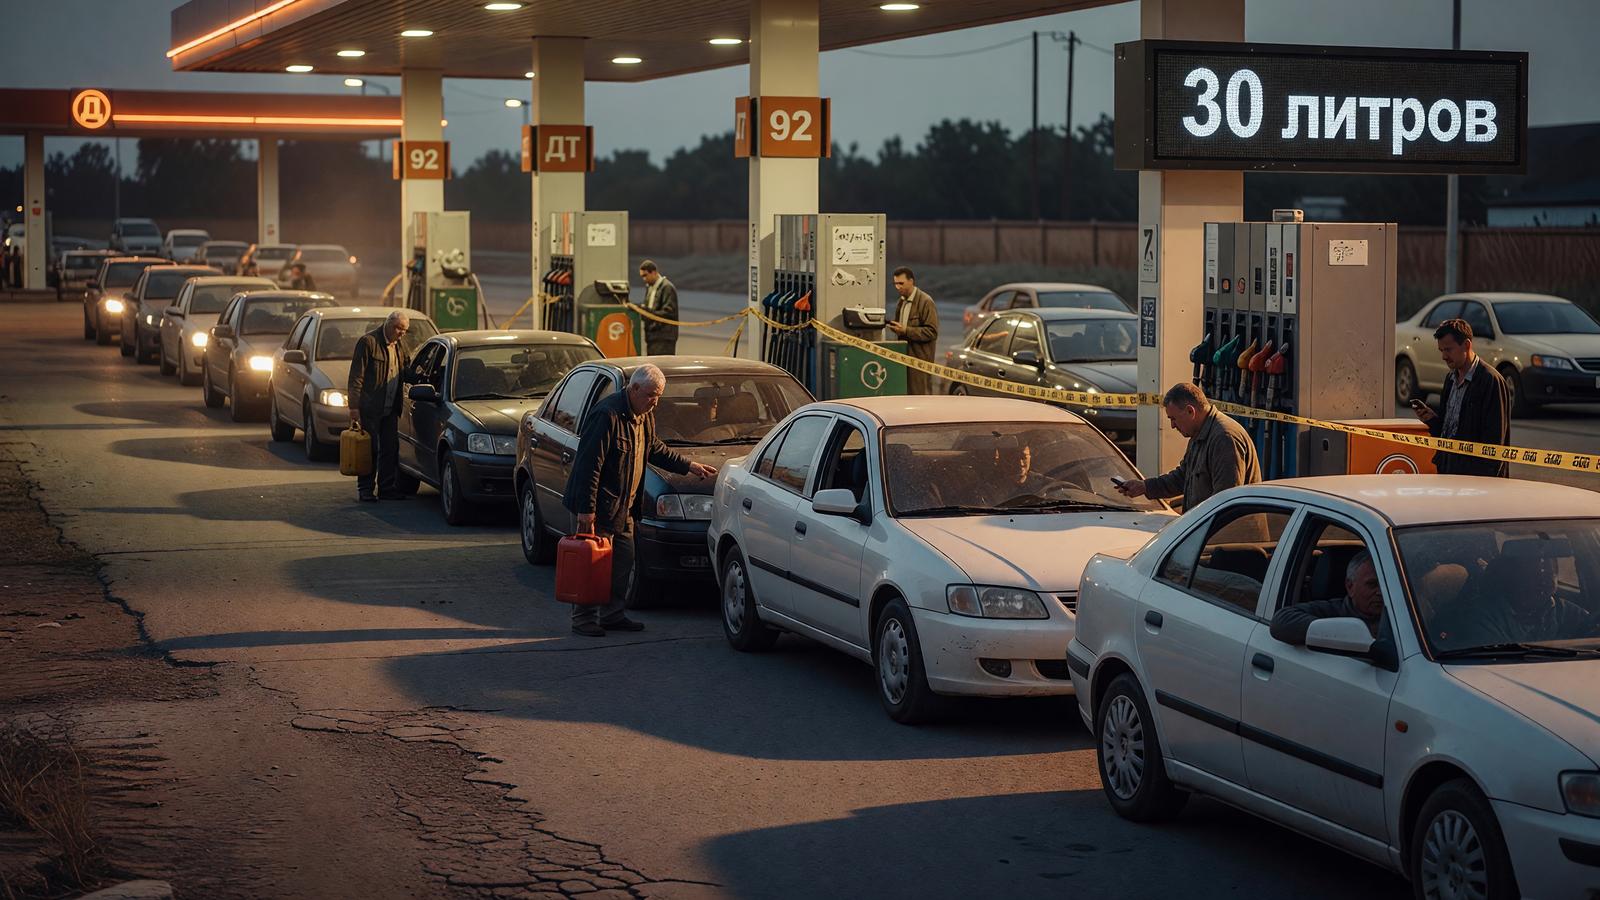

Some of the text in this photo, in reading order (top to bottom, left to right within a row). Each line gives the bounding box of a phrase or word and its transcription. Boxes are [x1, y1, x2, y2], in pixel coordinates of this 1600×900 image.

[769, 109, 813, 141] 92
[1182, 67, 1498, 156] 30 литров
[410, 148, 439, 170] 92
[544, 135, 581, 163] ДТ
